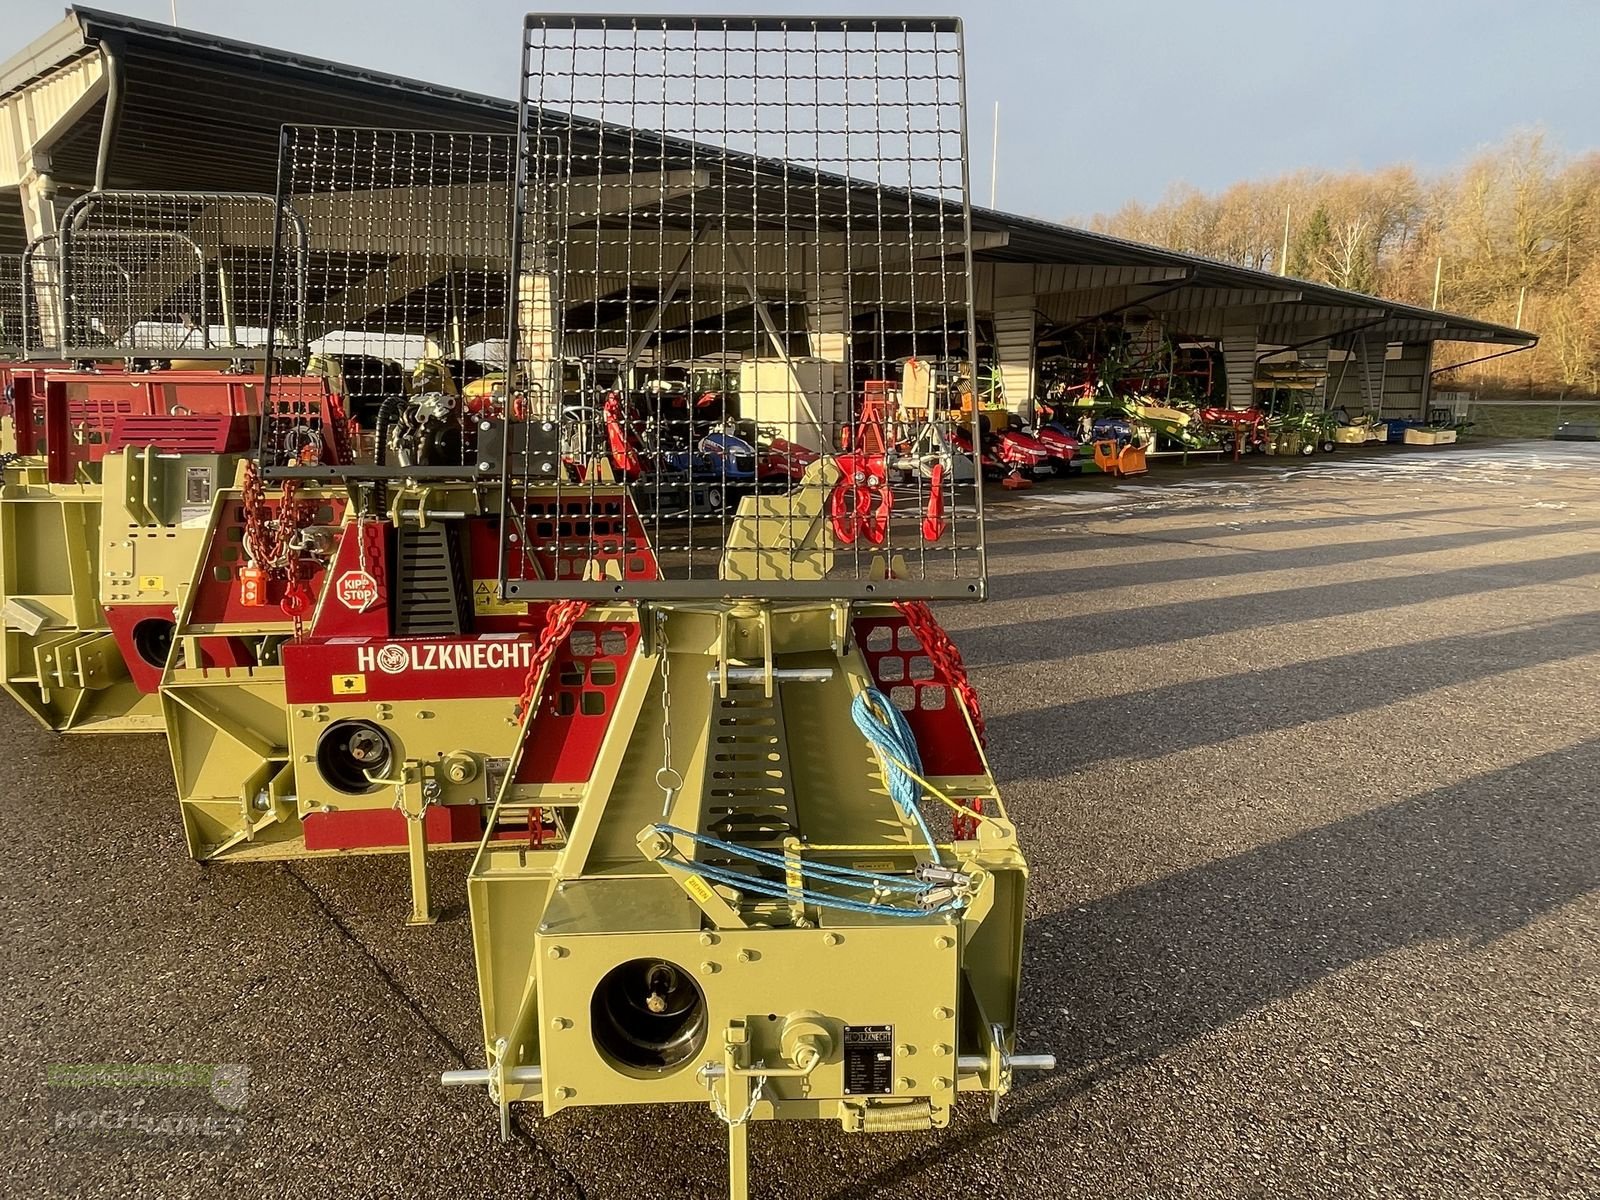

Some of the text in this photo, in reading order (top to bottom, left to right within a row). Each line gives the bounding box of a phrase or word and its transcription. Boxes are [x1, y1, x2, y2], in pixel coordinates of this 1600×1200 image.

[345, 579, 369, 590] KIPP
[343, 590, 372, 601] STOP
[357, 642, 533, 674] HOLZKNECHT
